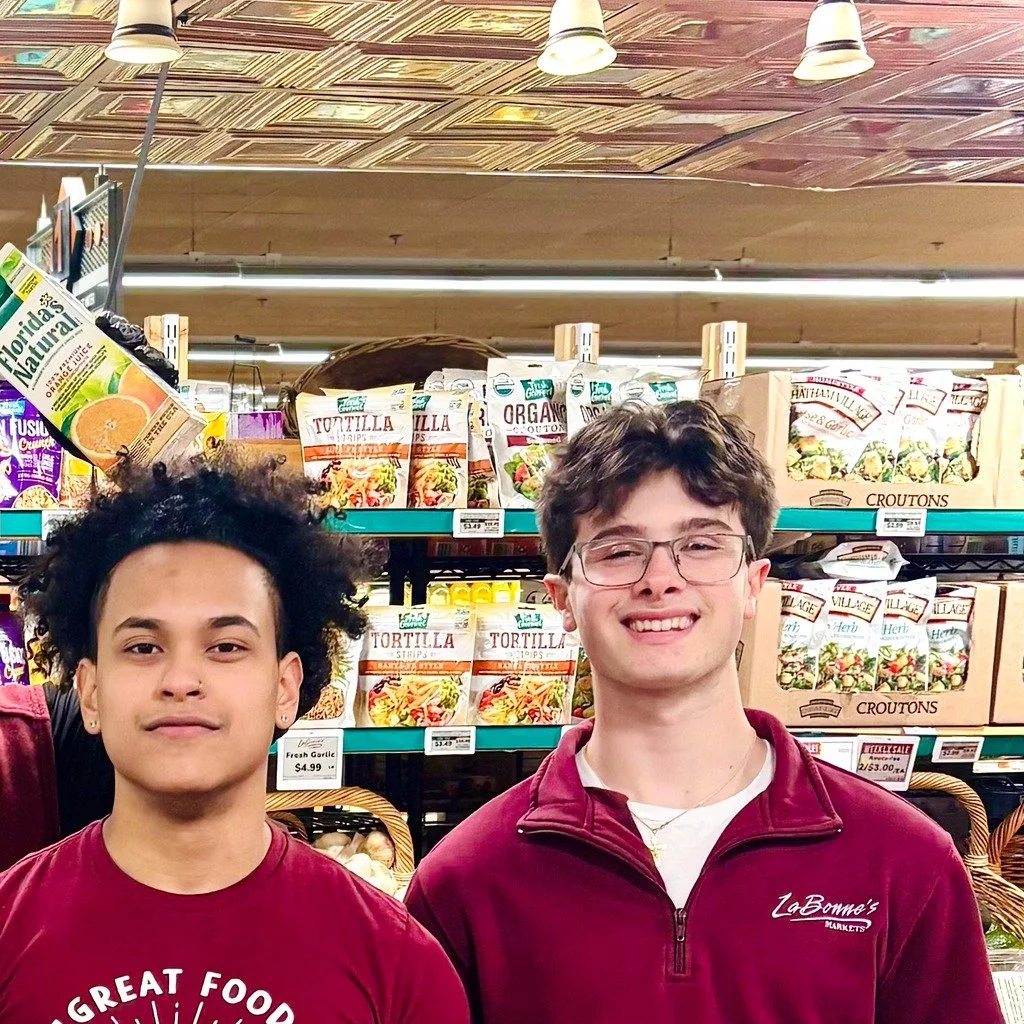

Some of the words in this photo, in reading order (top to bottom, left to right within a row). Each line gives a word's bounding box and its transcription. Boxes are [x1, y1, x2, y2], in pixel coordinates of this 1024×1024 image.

[13, 310, 80, 388] Natural
[45, 365, 73, 398] ORANGE
[73, 342, 93, 366] JUICE
[9, 418, 50, 437] FUSIO
[312, 414, 394, 434] TORTILLA
[865, 493, 949, 508] CROUTONS
[831, 596, 876, 615] VILLAGE
[883, 622, 910, 634] Herb
[371, 632, 455, 649] TORTILLA
[490, 632, 567, 649] TORTILLA
[856, 700, 939, 716] CROUTONS
[285, 751, 309, 759] Fresh
[892, 745, 911, 754] SALE
[294, 763, 322, 773] $4.99
[771, 892, 880, 918] LaBonne's
[824, 920, 865, 933] MARKETS
[67, 968, 183, 1023] GREAT
